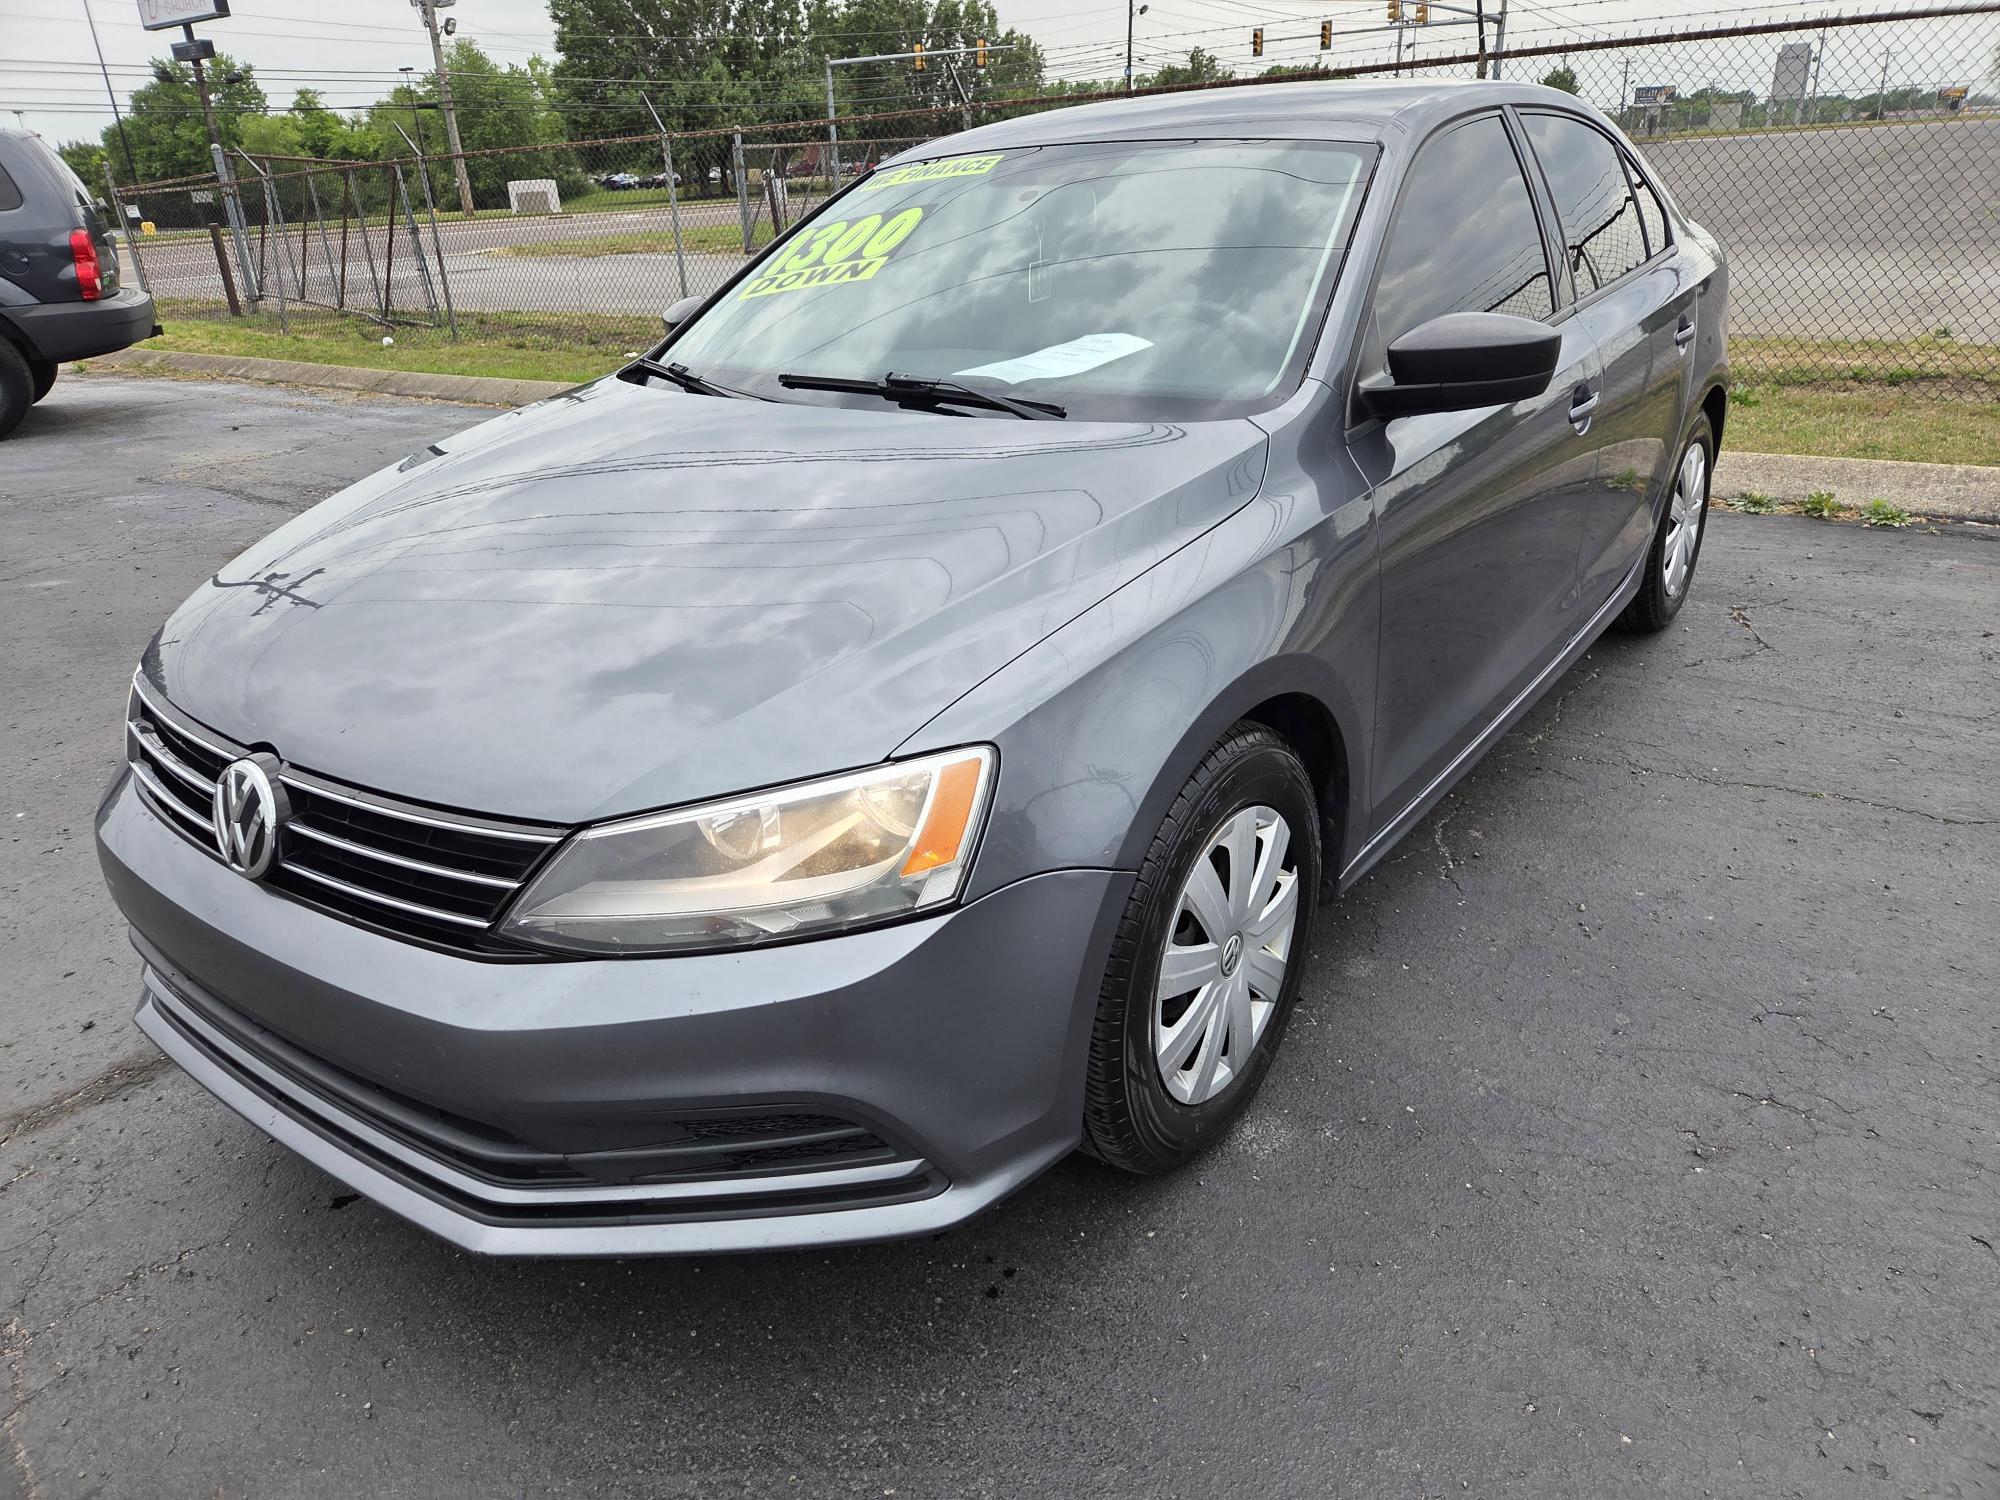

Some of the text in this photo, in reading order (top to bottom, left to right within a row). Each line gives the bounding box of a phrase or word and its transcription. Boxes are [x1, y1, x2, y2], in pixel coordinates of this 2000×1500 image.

[867, 158, 997, 187] WE FINANCE
[764, 208, 923, 277] 1300
[746, 260, 876, 296] DOWN
